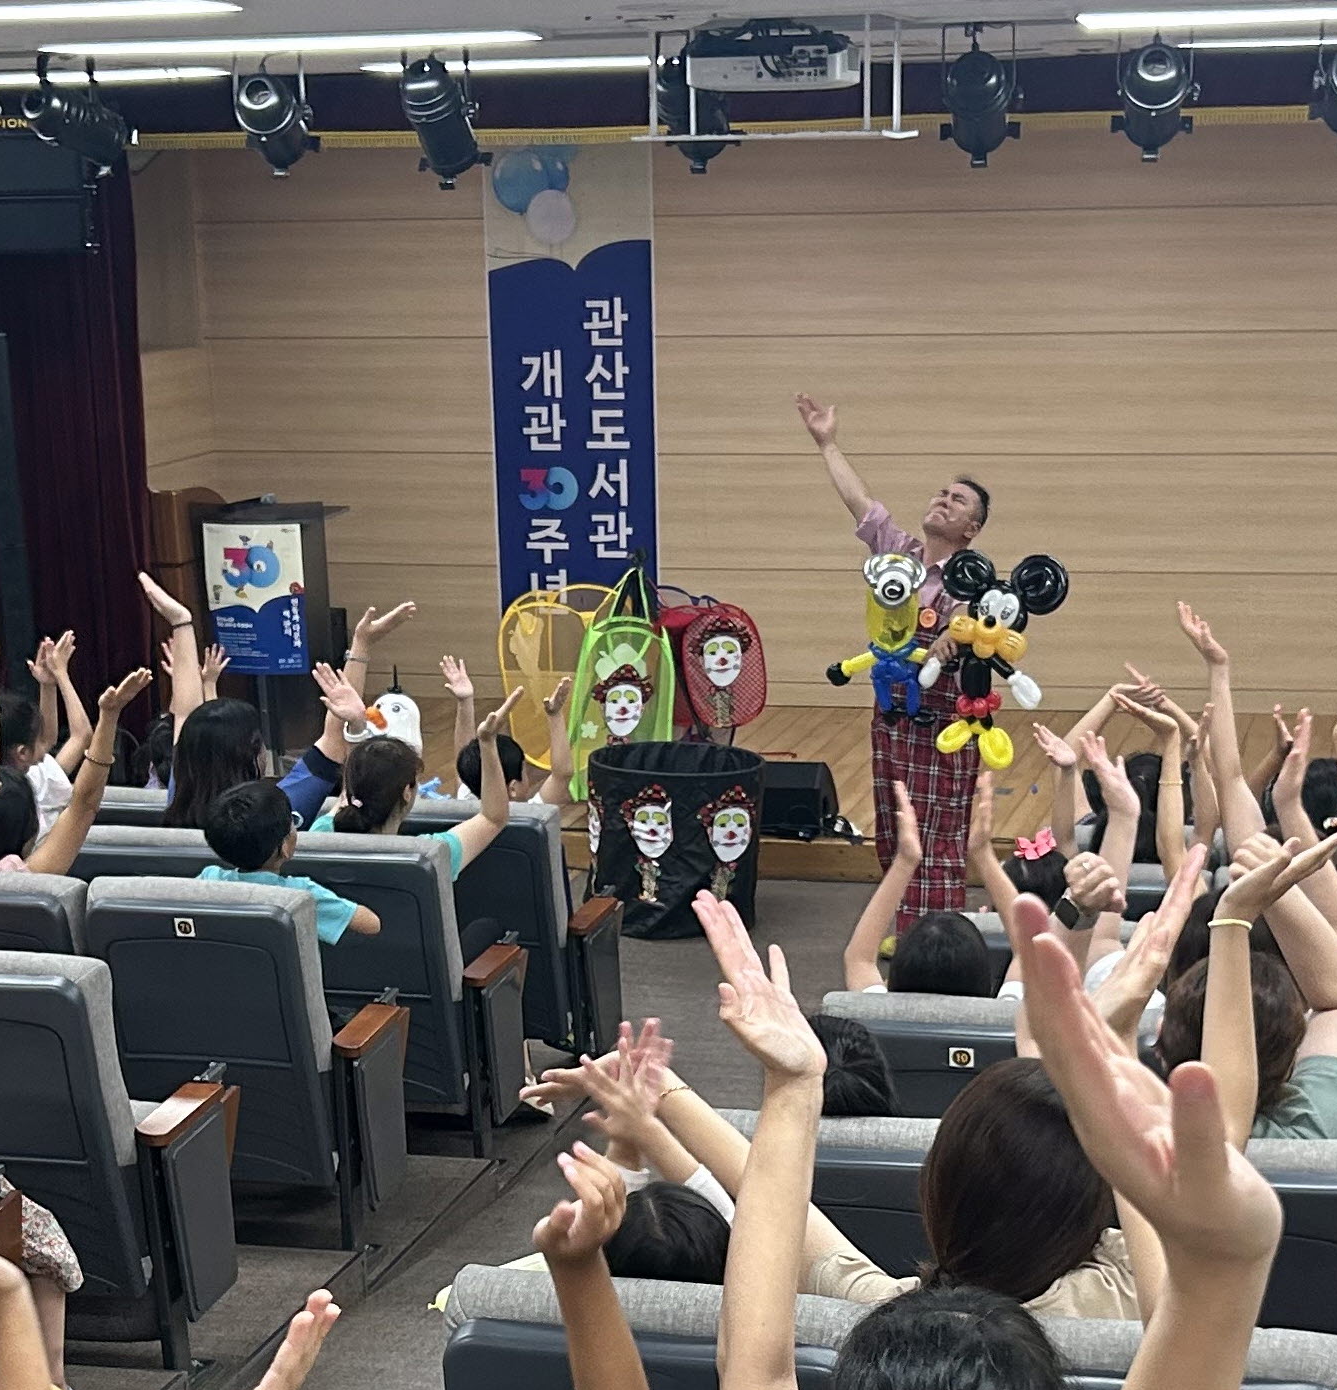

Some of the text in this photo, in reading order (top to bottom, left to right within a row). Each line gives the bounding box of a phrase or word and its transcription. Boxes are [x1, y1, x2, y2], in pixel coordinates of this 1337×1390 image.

[520, 348, 568, 453] 개관
[582, 296, 634, 560] 관산도서관
[955, 1052, 969, 1063] 10
